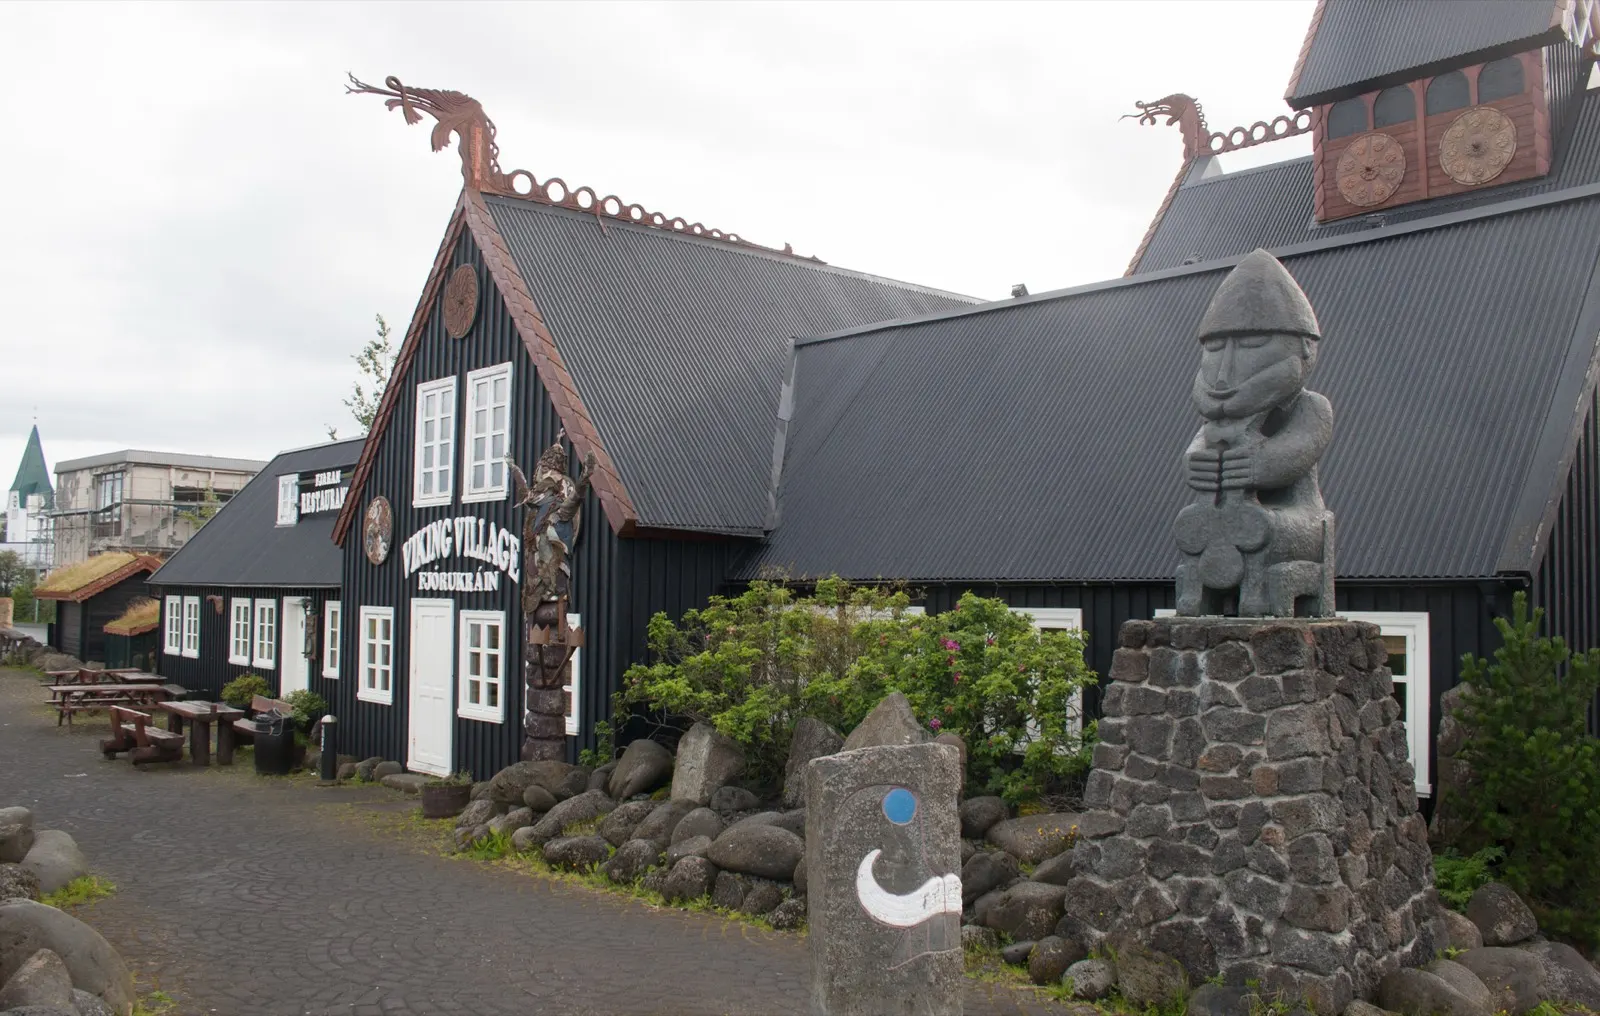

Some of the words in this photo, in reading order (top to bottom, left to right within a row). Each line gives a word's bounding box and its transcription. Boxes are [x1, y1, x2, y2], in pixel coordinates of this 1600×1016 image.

[301, 486, 349, 514] RESTAURAN
[402, 518, 452, 579] VIKING
[454, 516, 520, 584] VILLAGE
